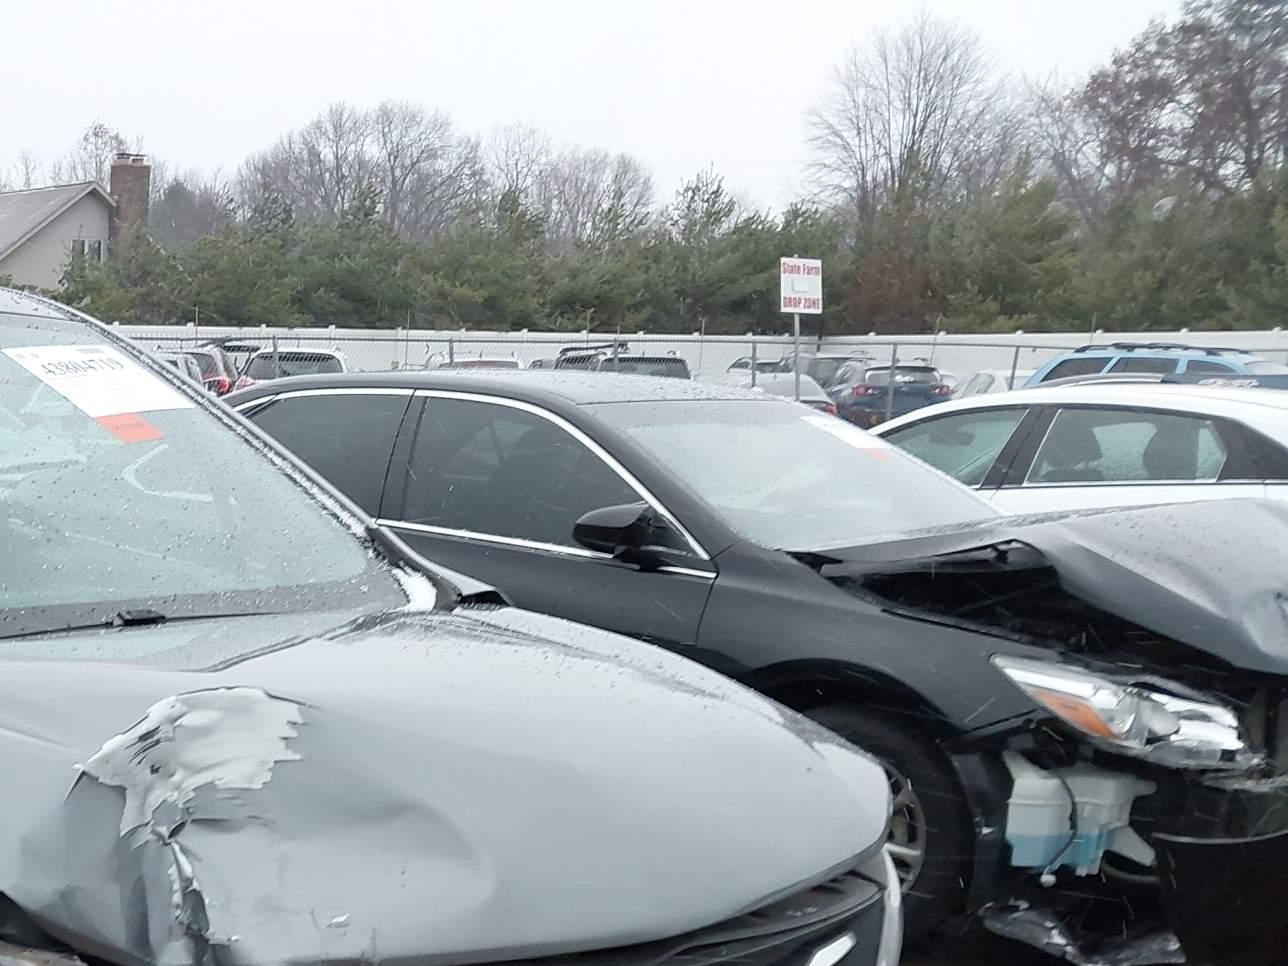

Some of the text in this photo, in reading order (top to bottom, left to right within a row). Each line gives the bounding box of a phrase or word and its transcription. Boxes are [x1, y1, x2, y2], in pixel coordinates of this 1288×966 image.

[782, 262, 821, 276] State Farm
[783, 296, 821, 310] DROP ZONE
